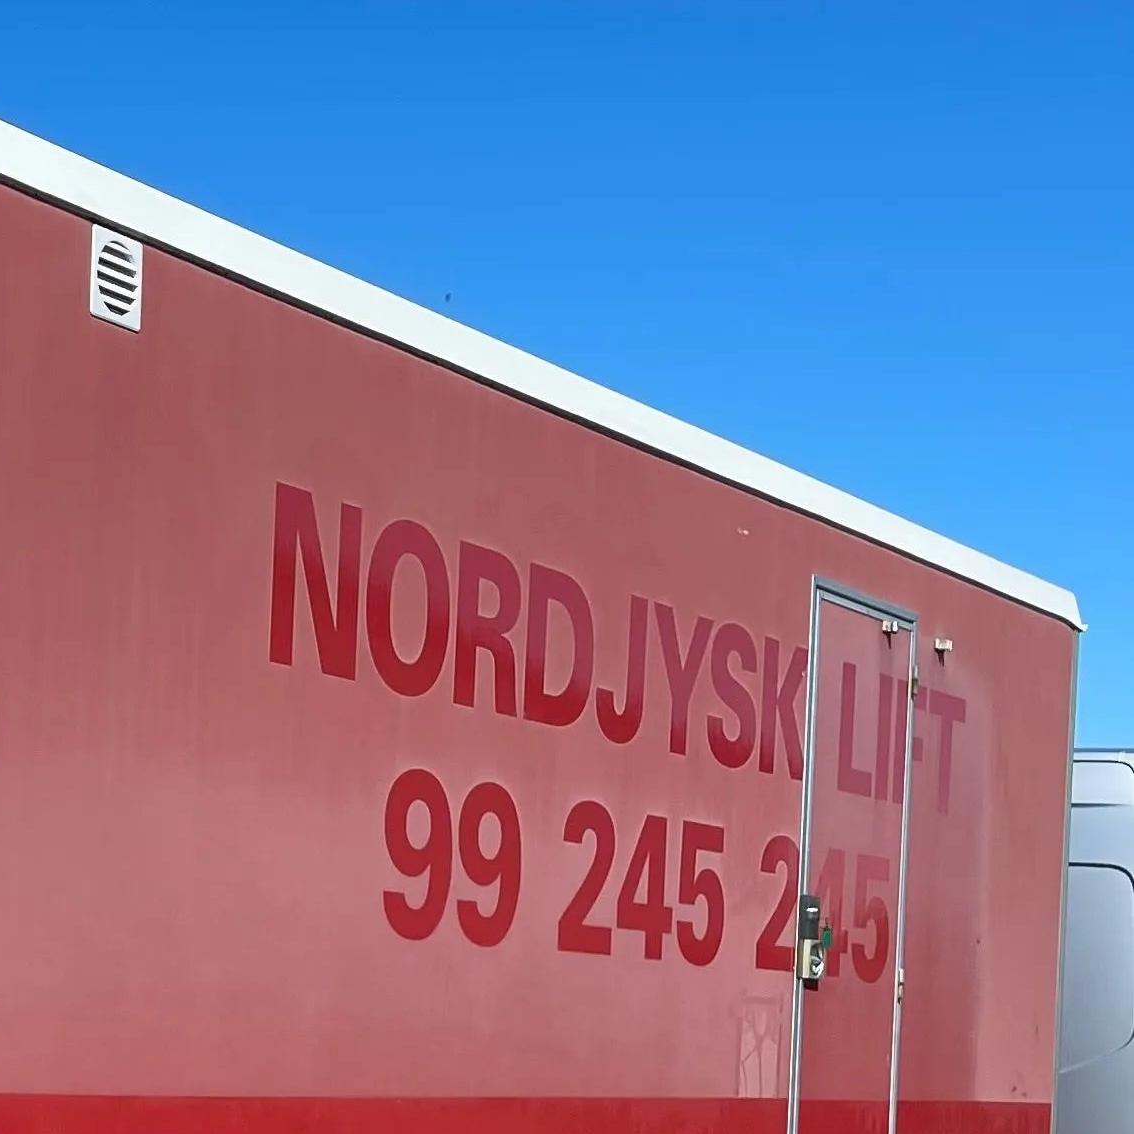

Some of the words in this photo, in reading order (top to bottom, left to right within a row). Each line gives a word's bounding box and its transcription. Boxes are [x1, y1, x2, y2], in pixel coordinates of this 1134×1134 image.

[268, 481, 808, 782] NORDJYSK
[837, 661, 966, 816] LIFT
[382, 768, 522, 948] 99
[557, 800, 726, 968] 245
[755, 834, 891, 984] 245
